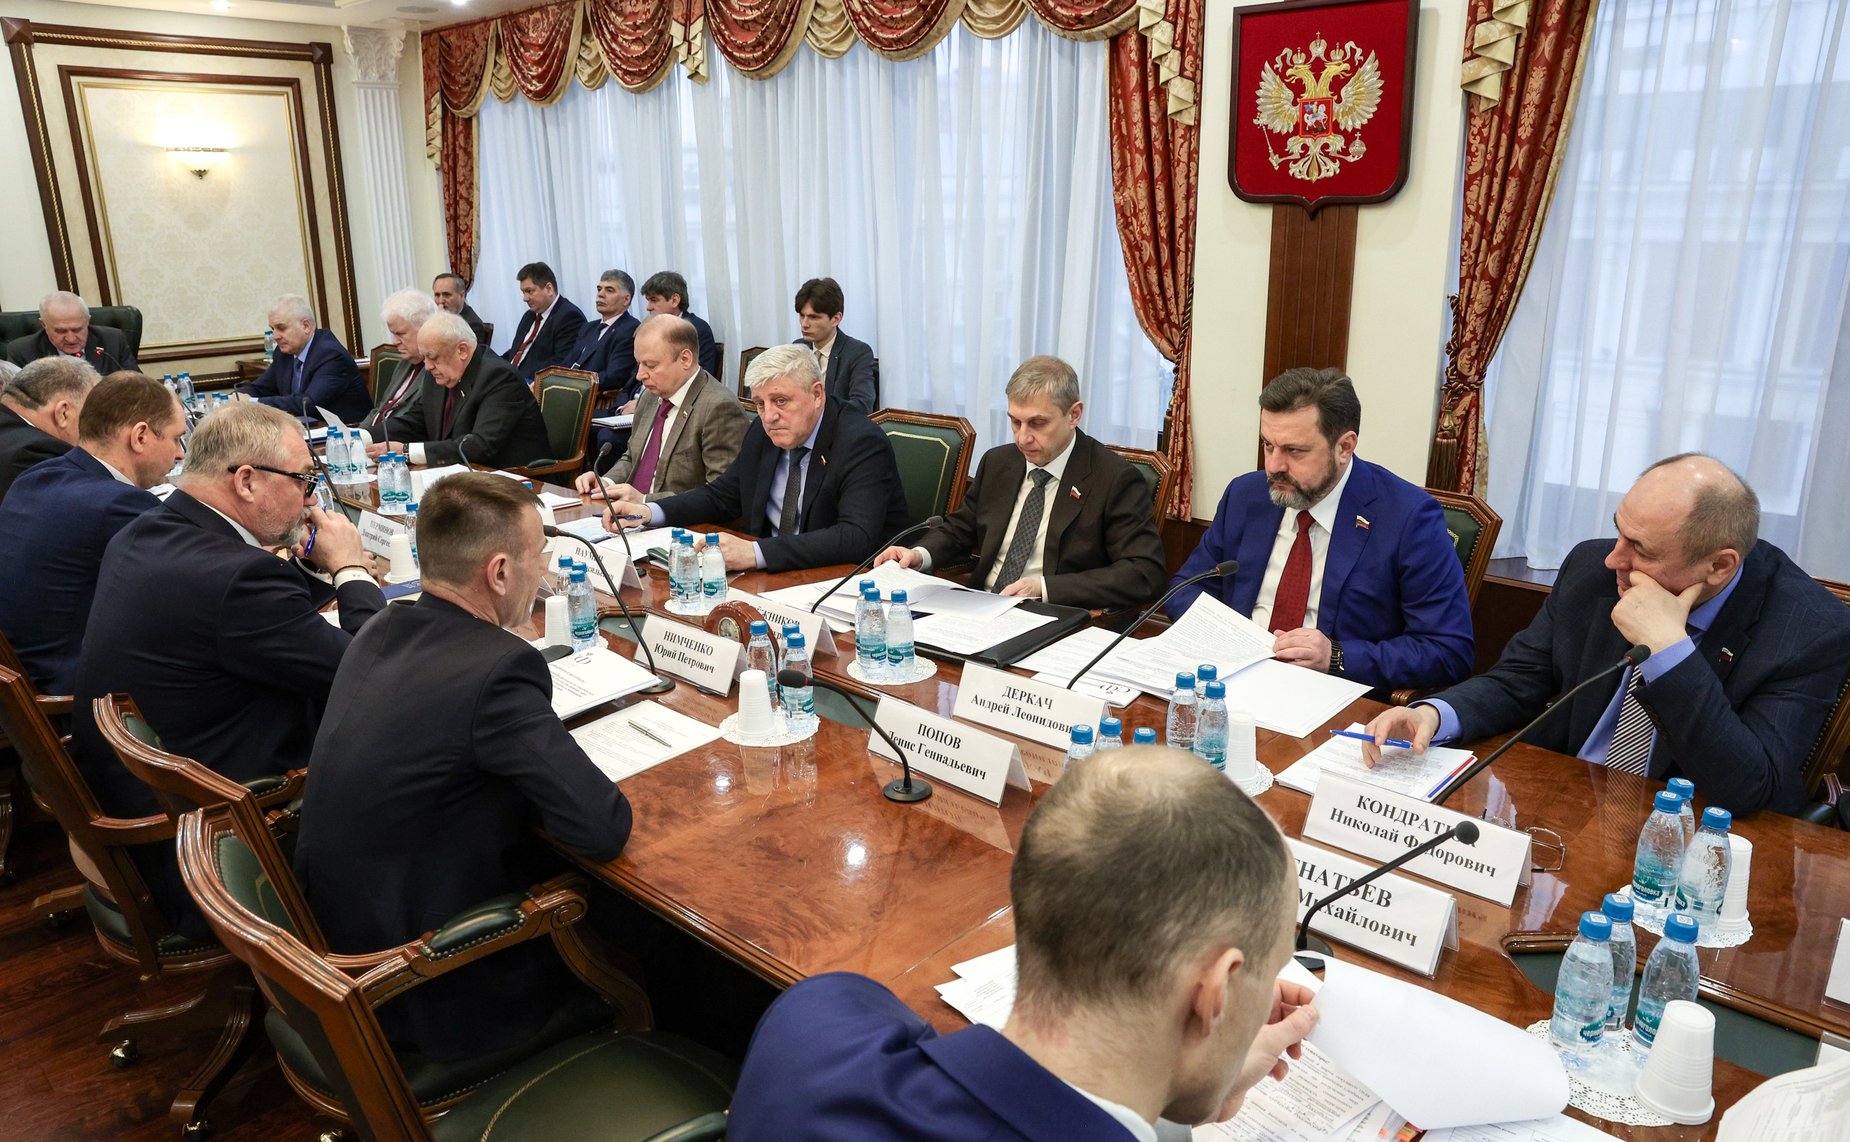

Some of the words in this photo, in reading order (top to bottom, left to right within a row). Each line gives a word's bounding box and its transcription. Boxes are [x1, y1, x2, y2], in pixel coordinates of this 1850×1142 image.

[654, 643, 677, 660] Юрий
[678, 651, 715, 673] Петрович
[664, 631, 713, 656] НИМЧЕНКО
[971, 694, 1009, 714] Андрей
[1011, 706, 1072, 734] Леонидови
[1002, 686, 1053, 710] ДЕРКАЧ
[917, 723, 961, 749] ПОПОВ
[918, 743, 986, 780] Геннадьевич
[1356, 795, 1476, 848] КОНДРАТ
[1329, 808, 1399, 843] Николай
[1403, 834, 1496, 878] Фдорович
